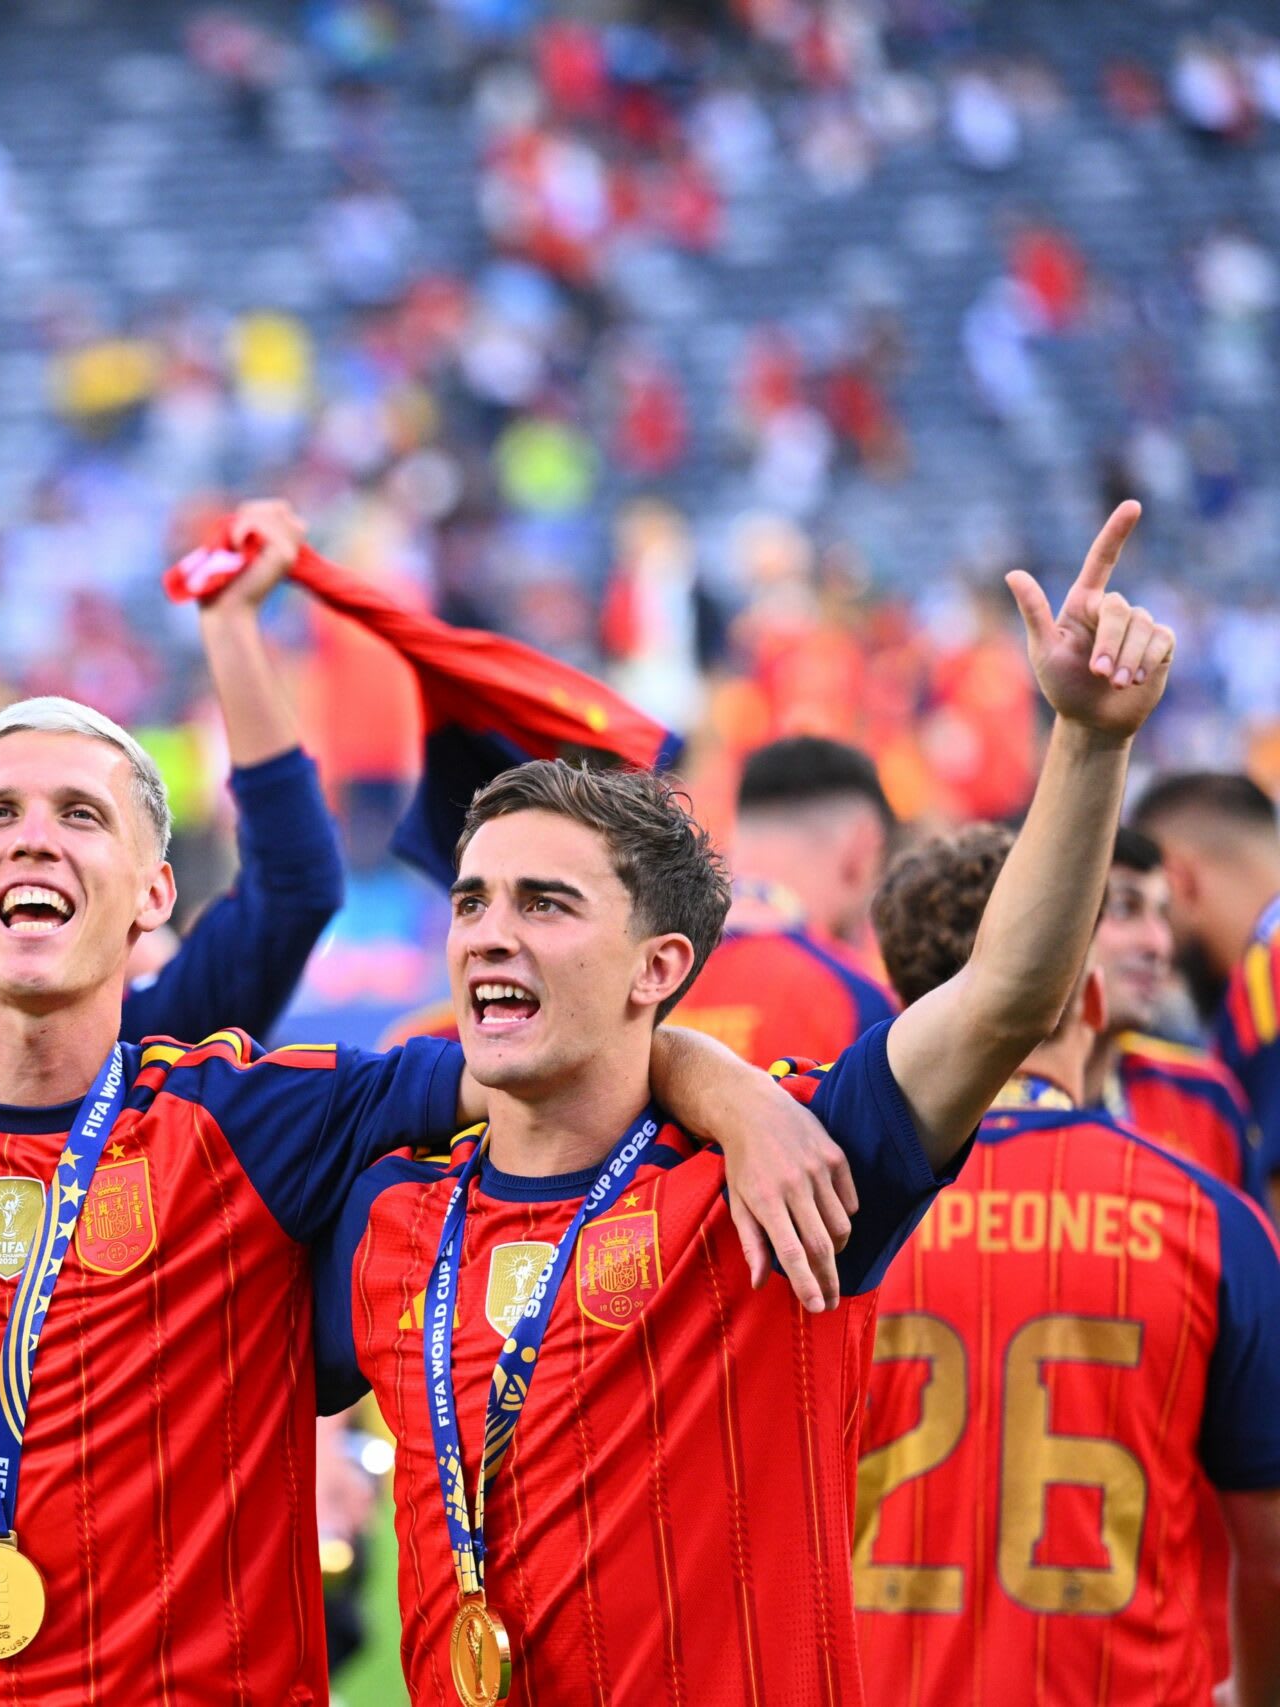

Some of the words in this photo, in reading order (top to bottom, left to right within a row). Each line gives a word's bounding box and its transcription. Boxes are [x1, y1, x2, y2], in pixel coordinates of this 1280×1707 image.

[81, 1101, 111, 1138] FIFA
[586, 1174, 612, 1210] CUP
[609, 1120, 657, 1178] 2026
[437, 1261, 451, 1300] CUP
[503, 1304, 526, 1316] FIF
[431, 1303, 448, 1379] WORLD
[434, 1380, 450, 1428] FIFA
[851, 1311, 1148, 1616] 26
